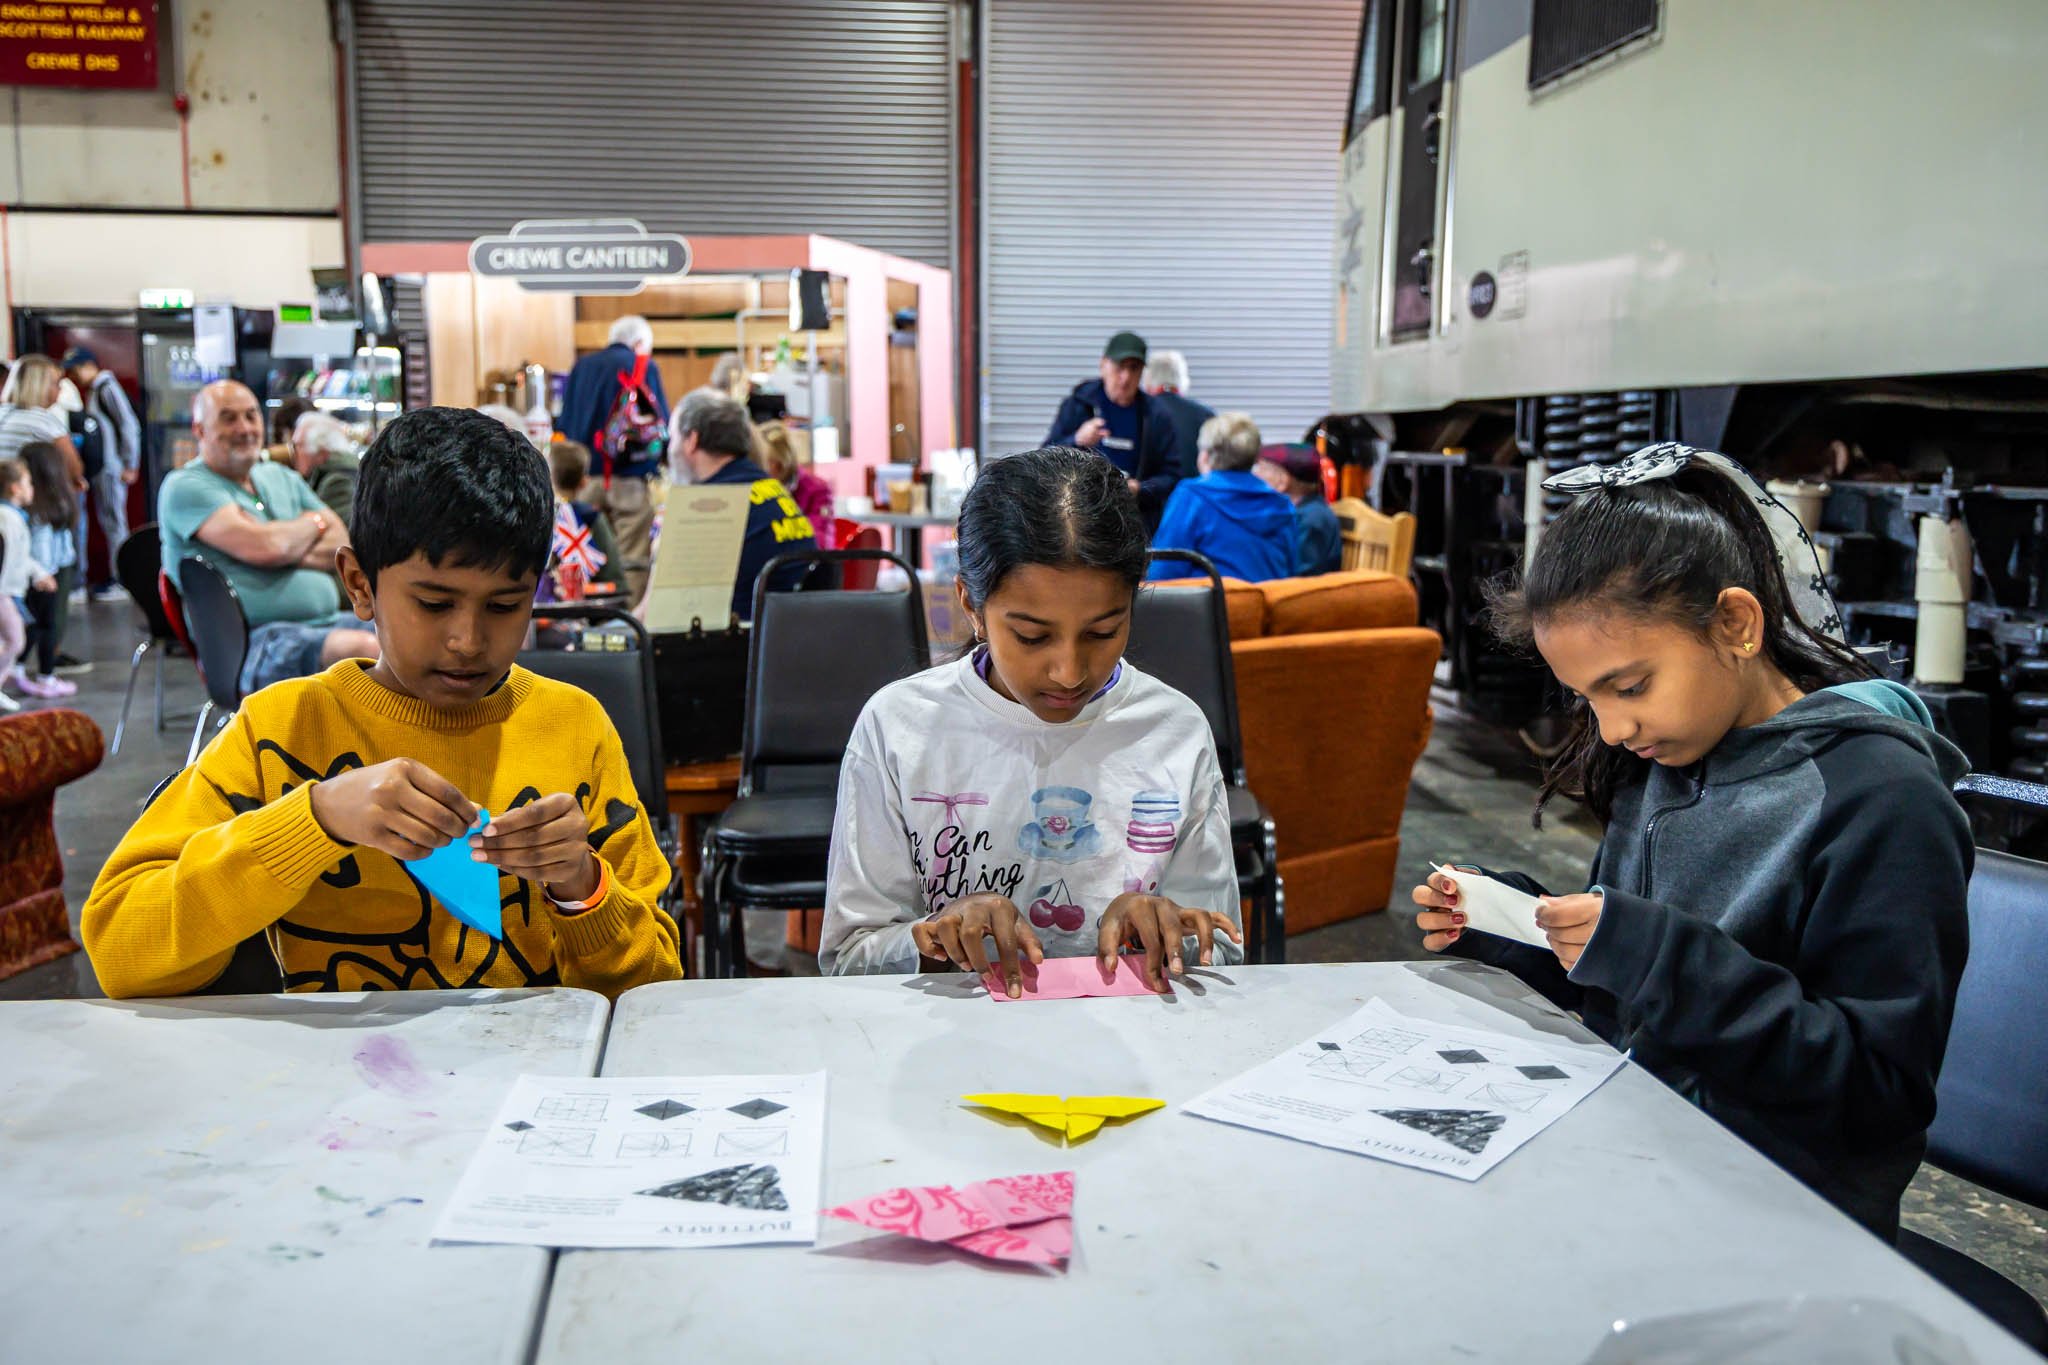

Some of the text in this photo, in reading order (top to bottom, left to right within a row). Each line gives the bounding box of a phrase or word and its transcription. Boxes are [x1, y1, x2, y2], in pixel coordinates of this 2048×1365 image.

[1, 4, 142, 23] ENGLISH WELSH &
[75, 24, 145, 41] RAILWAY
[26, 51, 81, 70] CREWE
[488, 246, 669, 270] CREWE CANTEEN
[934, 825, 993, 859] Can
[1360, 1138, 1471, 1166] BUTTERFLY
[656, 1221, 792, 1234] BUTTERFLY
